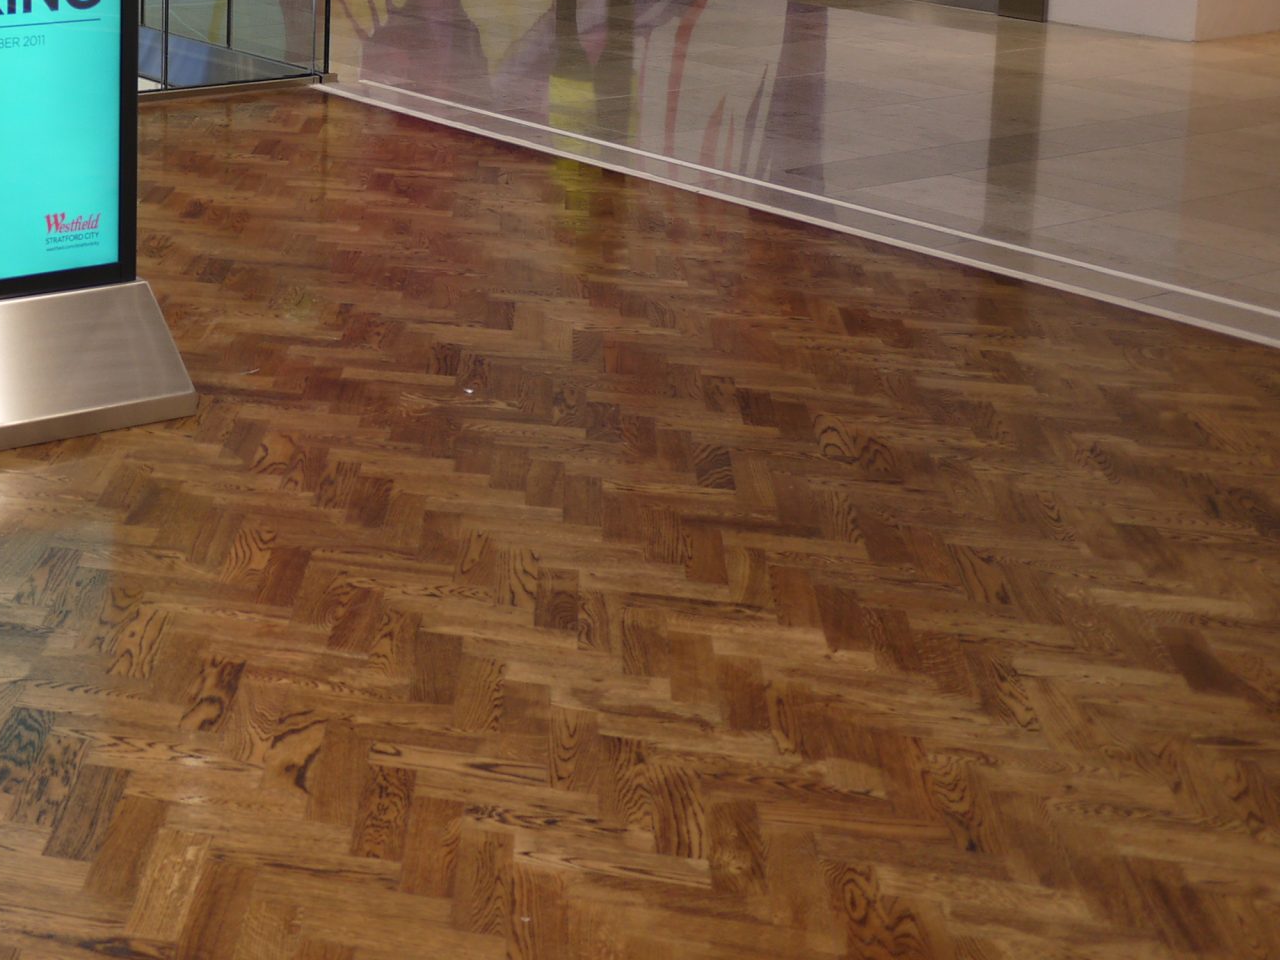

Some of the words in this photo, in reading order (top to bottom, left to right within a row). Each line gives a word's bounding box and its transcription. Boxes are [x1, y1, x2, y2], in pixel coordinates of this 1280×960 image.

[22, 35, 45, 47] 2011
[45, 212, 101, 234] Westfield
[46, 234, 83, 245] STRATFORD
[84, 232, 99, 240] CITY
